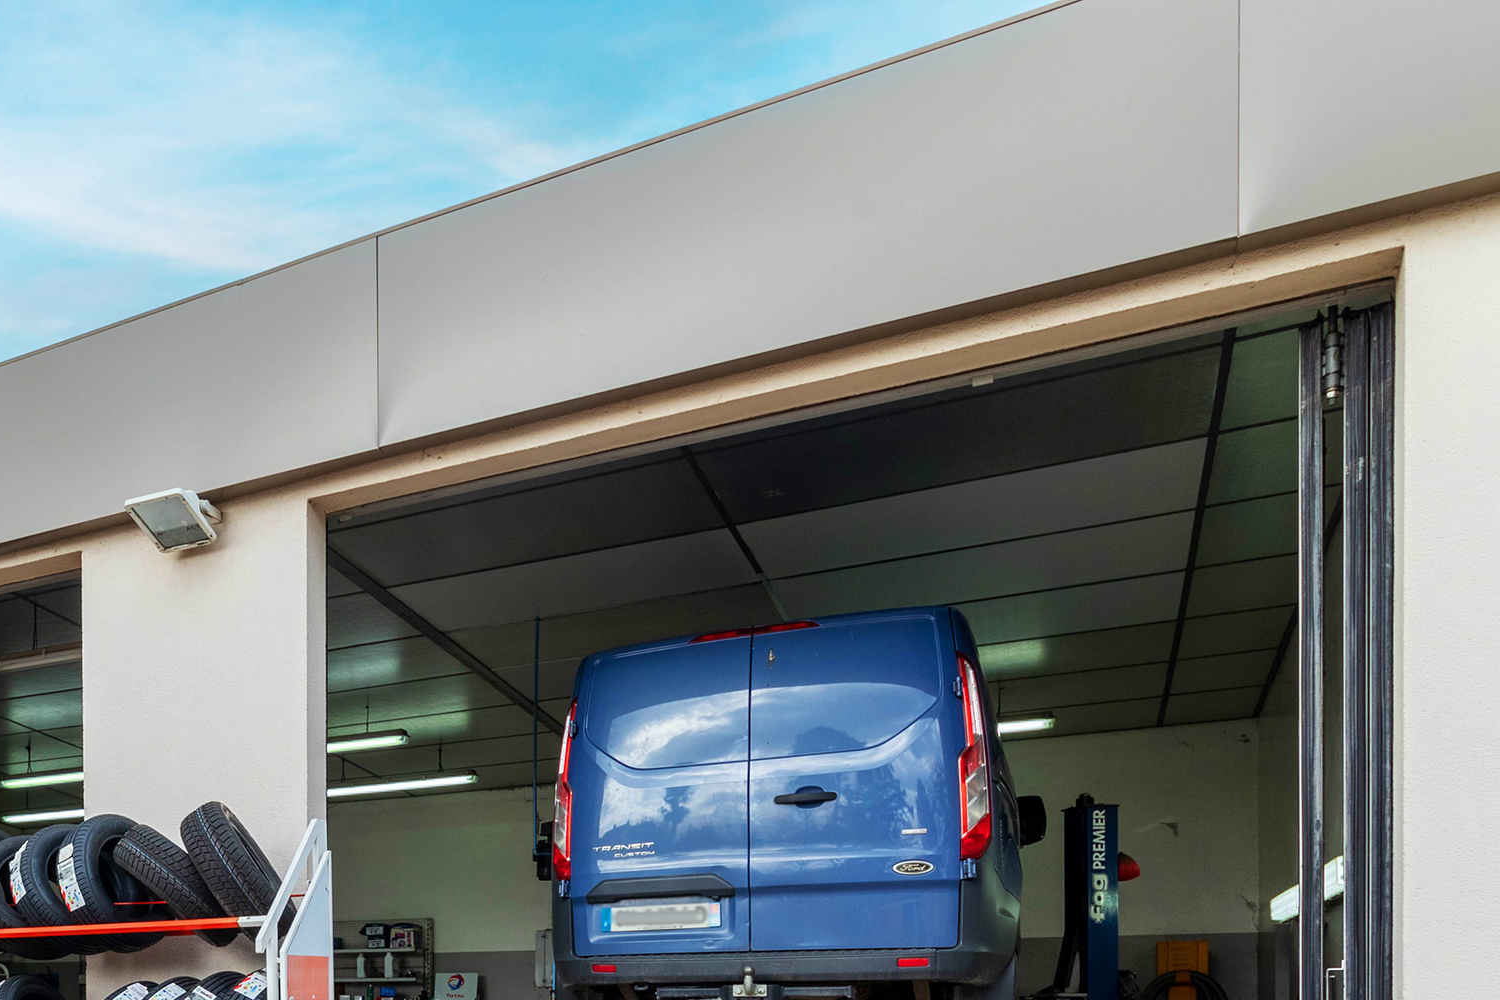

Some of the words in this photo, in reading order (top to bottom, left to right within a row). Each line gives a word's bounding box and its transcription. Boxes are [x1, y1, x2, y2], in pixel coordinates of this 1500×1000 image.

[592, 841, 655, 853] TRANSIT
[614, 850, 656, 858] CUSTOM
[1092, 809, 1106, 870] PREMIER
[1089, 873, 1108, 923] fog
